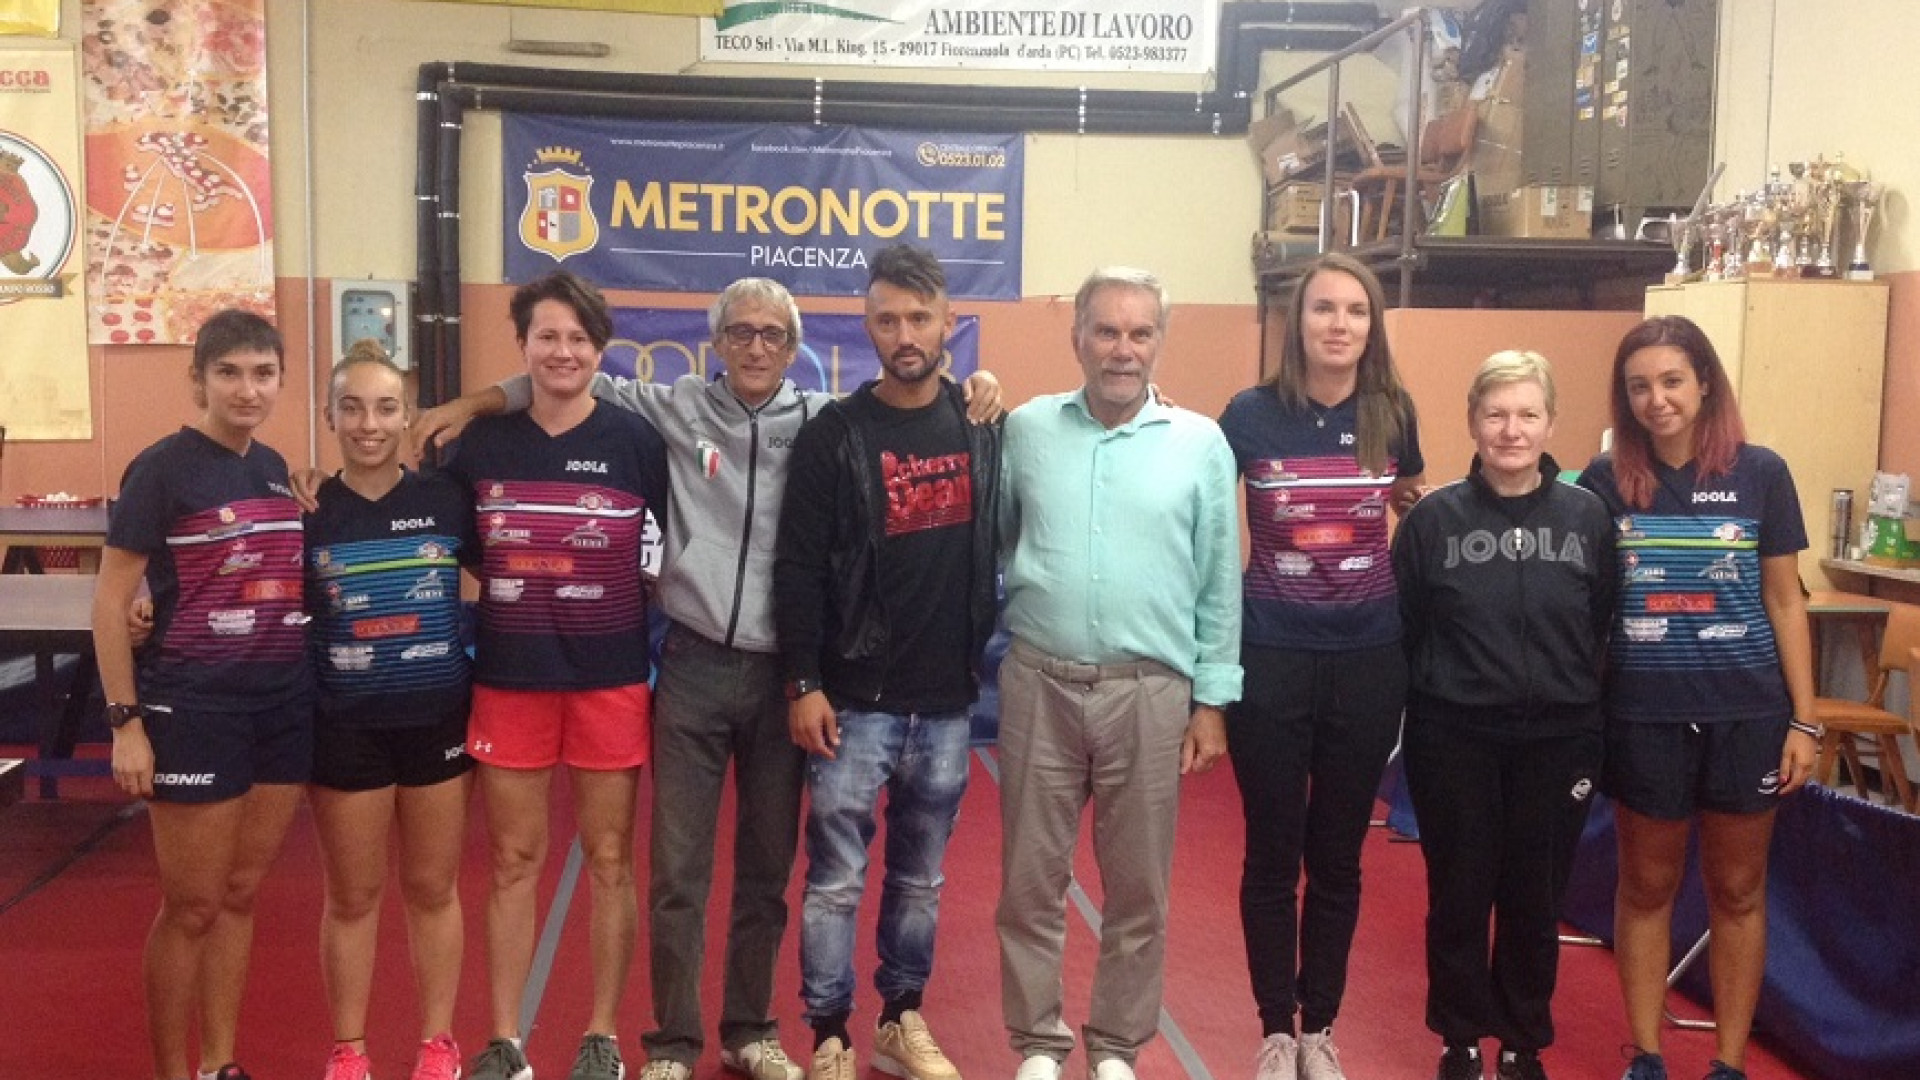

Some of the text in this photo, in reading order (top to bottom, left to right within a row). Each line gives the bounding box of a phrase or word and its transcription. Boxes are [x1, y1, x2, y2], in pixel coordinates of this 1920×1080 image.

[924, 9, 1194, 41] AMBIENTE DI LAVORO
[715, 35, 751, 50] TECO
[755, 36, 773, 51] Srl
[784, 37, 805, 52] Via
[808, 38, 834, 54] M.L.
[872, 39, 887, 54] 15
[899, 40, 937, 56] 29017
[1055, 45, 1081, 61] (PC)
[610, 180, 1005, 240] METRONOTTE
[751, 246, 868, 269] PIACENZA
[564, 460, 609, 474] JOOLA
[1692, 491, 1738, 503] JOOLA
[391, 517, 435, 531] JOOLA
[1443, 528, 1586, 569] JOOLA
